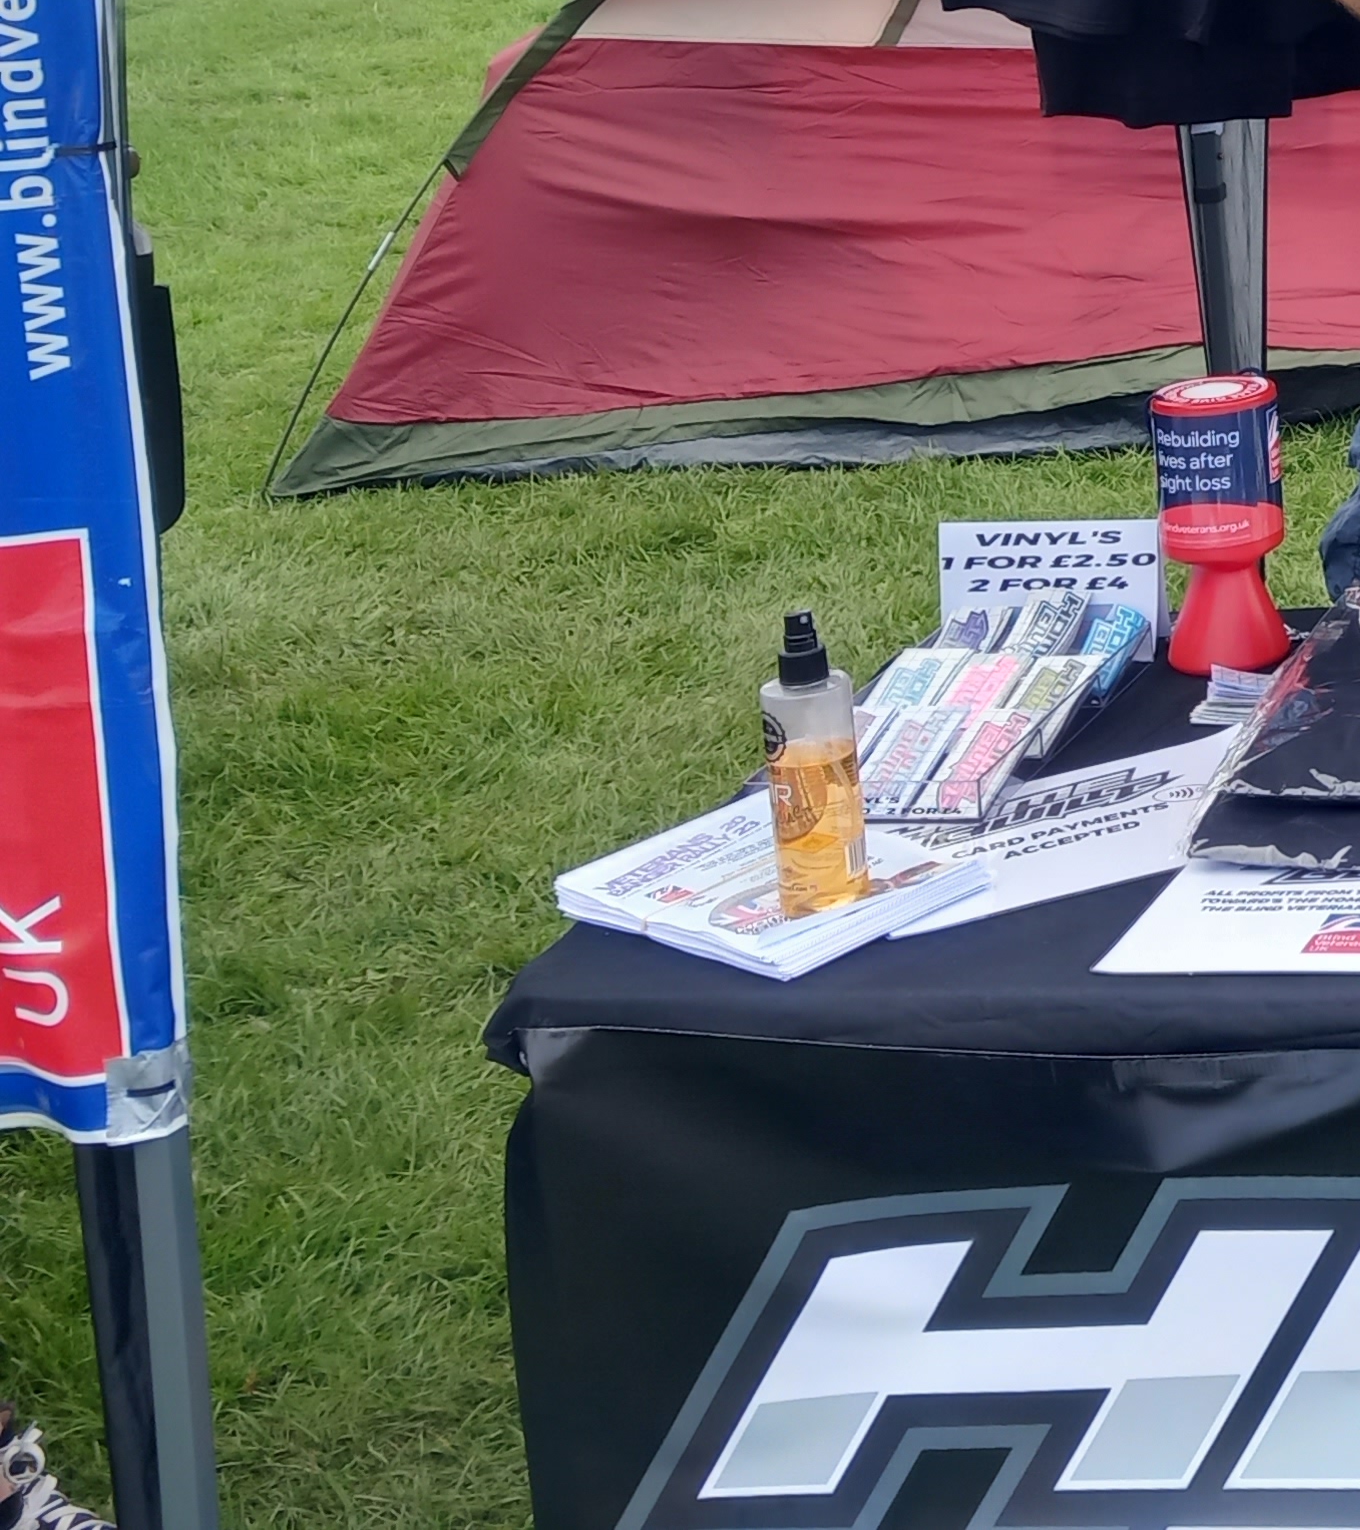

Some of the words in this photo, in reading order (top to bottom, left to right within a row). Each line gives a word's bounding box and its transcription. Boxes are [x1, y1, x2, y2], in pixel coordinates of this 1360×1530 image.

[1157, 427, 1241, 449] Rebuilding
[1158, 452, 1187, 470] lives
[1189, 451, 1234, 470] after
[1159, 474, 1193, 494] sight
[1195, 475, 1232, 491] loss
[975, 530, 1123, 548] VINYL'S
[941, 557, 955, 571] 1
[963, 555, 1043, 571] FOR
[1049, 552, 1157, 569] £2.50
[966, 578, 991, 593] 2
[998, 577, 1078, 592] FOR
[1085, 575, 1130, 591] £4
[951, 836, 1026, 859] CARD
[1029, 801, 1170, 841] PAYMENTS
[1002, 820, 1141, 860] ACCEPTED
[1203, 889, 1234, 897] ALL
[1237, 889, 1303, 897] PROFITS
[1306, 888, 1354, 896] FROM
[1317, 934, 1357, 942] Blind
[0, 893, 70, 1028] UK
